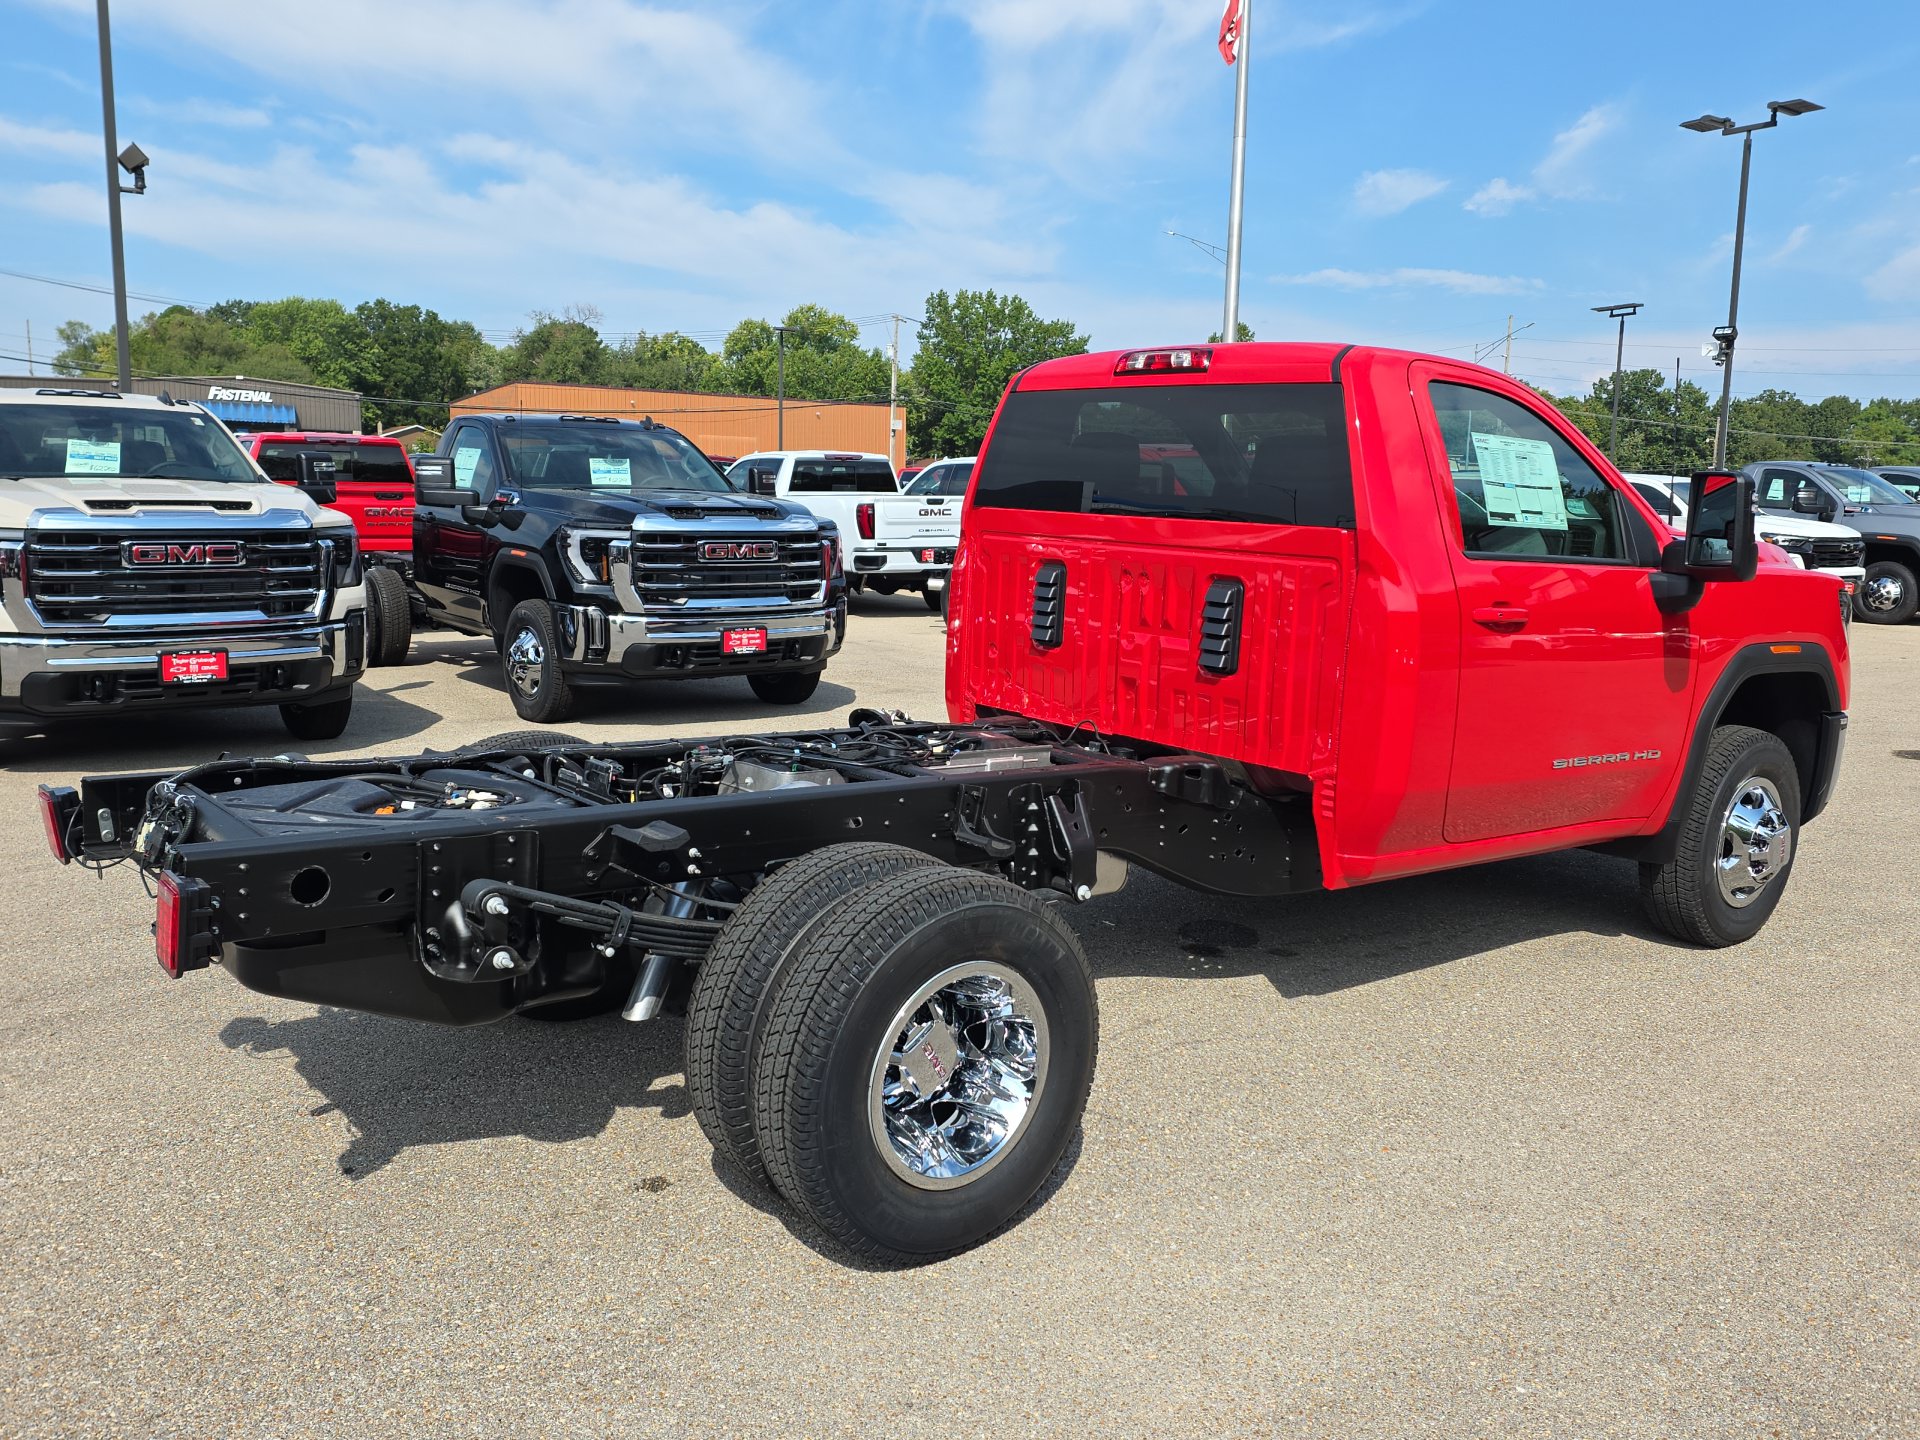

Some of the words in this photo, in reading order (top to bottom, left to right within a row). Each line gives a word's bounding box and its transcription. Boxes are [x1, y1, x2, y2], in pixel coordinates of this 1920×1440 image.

[208, 386, 273, 403] FASTENAL
[364, 507, 415, 517] GMC
[919, 508, 952, 516] GMC
[132, 544, 237, 564] GMC
[705, 543, 774, 558] GMC
[1552, 752, 1630, 769] SIERRA
[1633, 749, 1662, 761] HD
